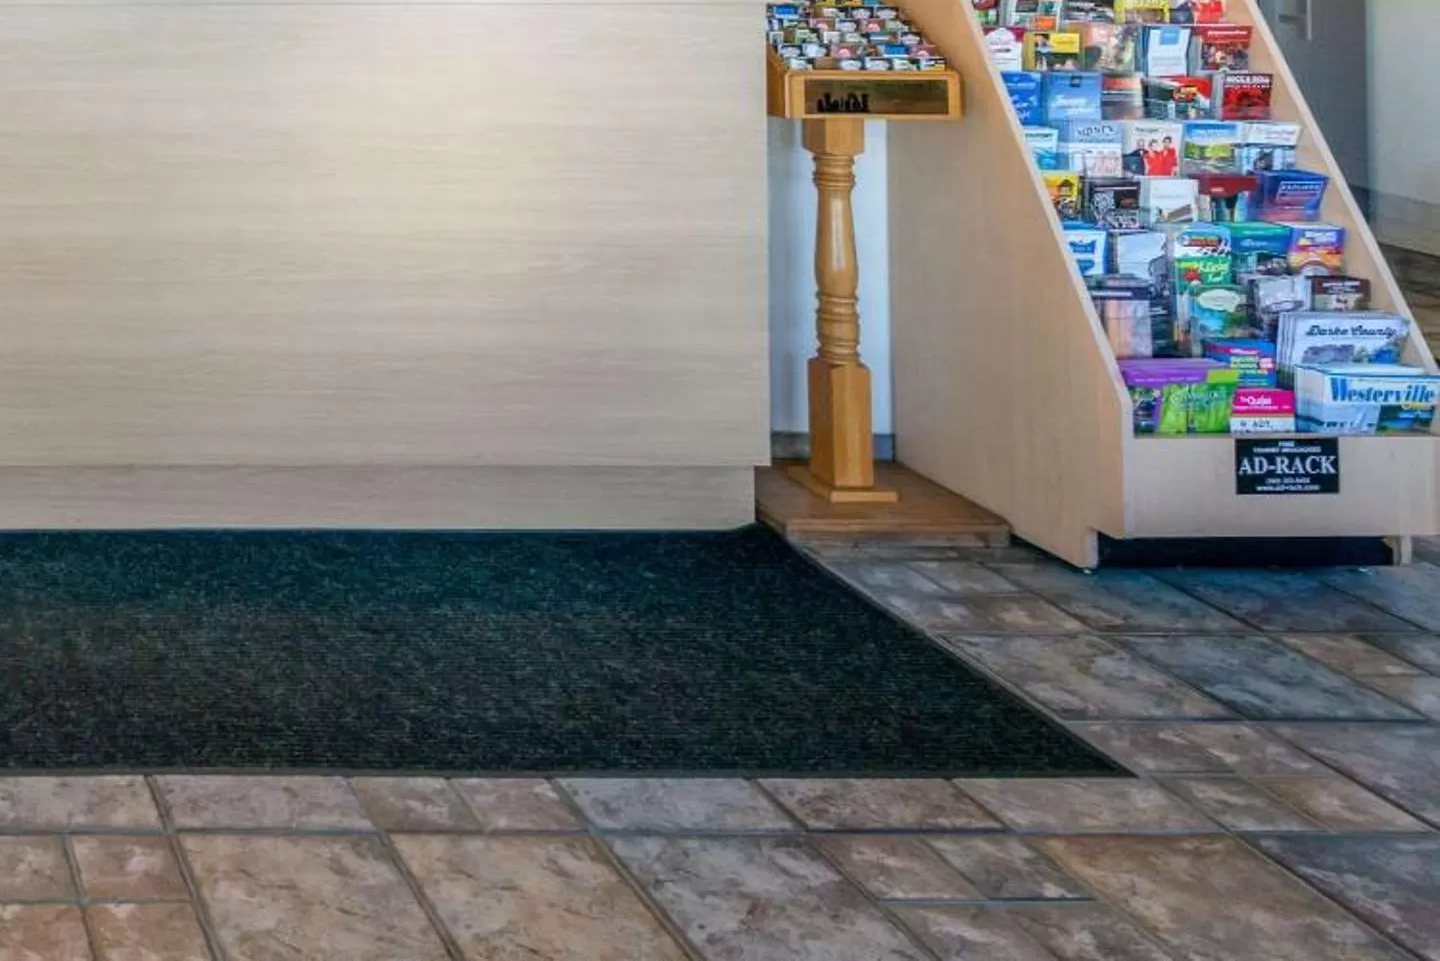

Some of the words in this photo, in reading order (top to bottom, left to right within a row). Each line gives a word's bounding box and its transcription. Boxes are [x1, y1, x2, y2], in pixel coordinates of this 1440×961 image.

[1305, 325, 1349, 337] Darke
[1351, 324, 1397, 339] County
[1330, 377, 1434, 403] Westerville
[1238, 455, 1337, 475] AD-RACK
